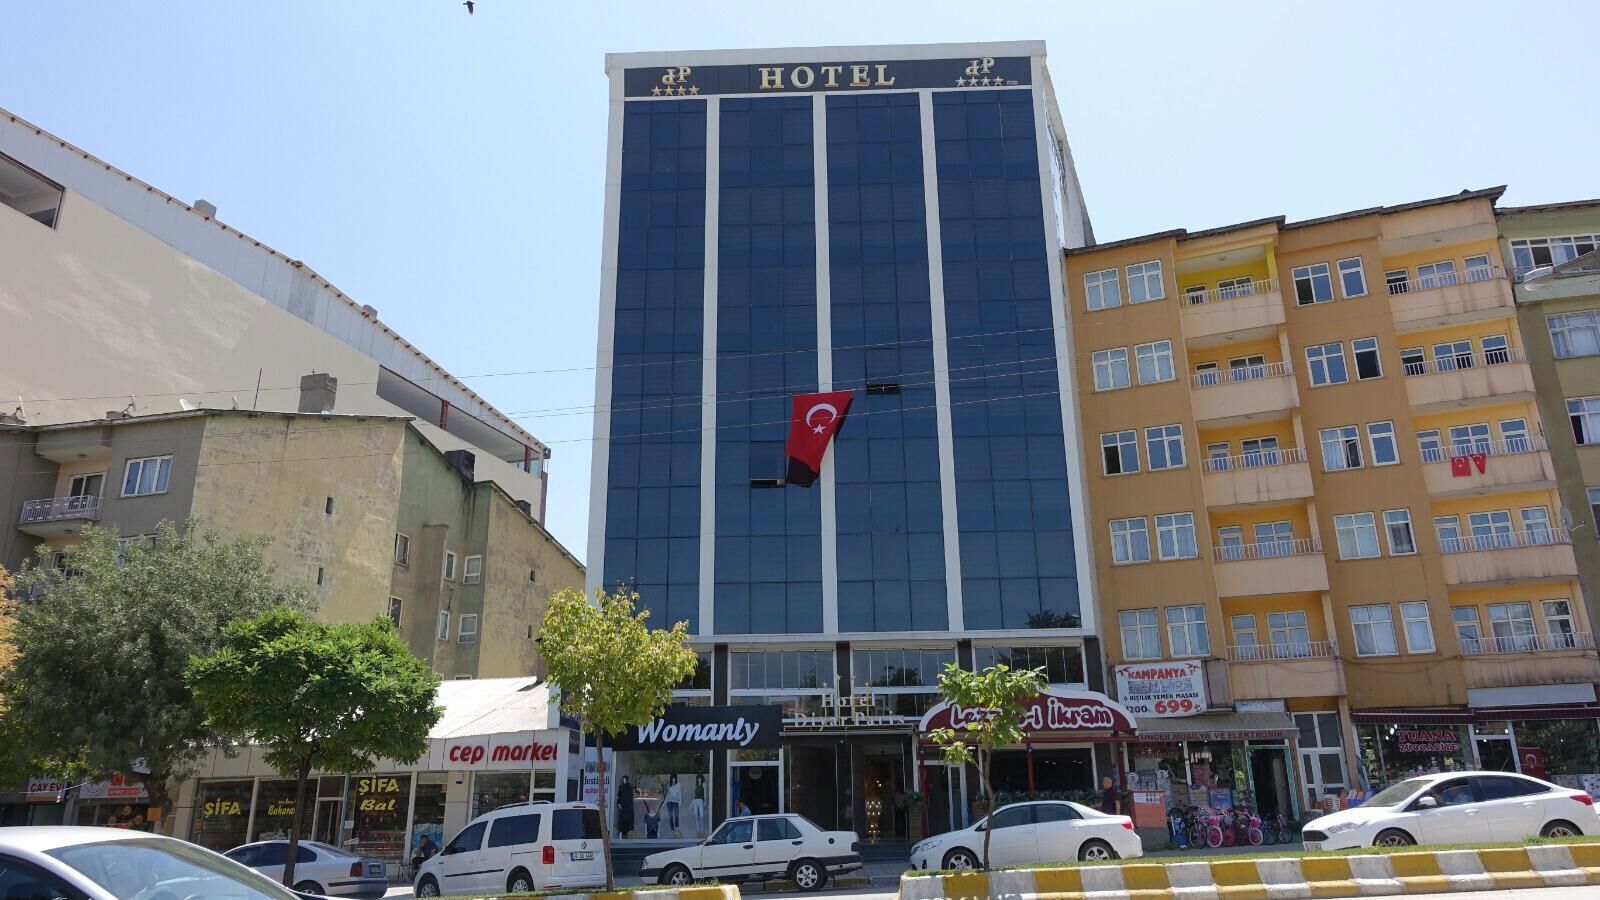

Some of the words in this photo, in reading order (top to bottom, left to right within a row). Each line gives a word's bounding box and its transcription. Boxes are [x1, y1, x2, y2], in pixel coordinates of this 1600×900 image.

[759, 64, 895, 90] HOTEL
[1128, 667, 1187, 680] KAMPANYA
[1048, 697, 1114, 729] İkram
[1155, 699, 1193, 714] 699
[638, 717, 760, 747] Womanly
[1396, 729, 1457, 742] TUANA
[449, 745, 485, 765] cep
[359, 774, 400, 795] ŞİFA
[204, 797, 241, 818] ŞİFA
[360, 799, 396, 811] Bal
